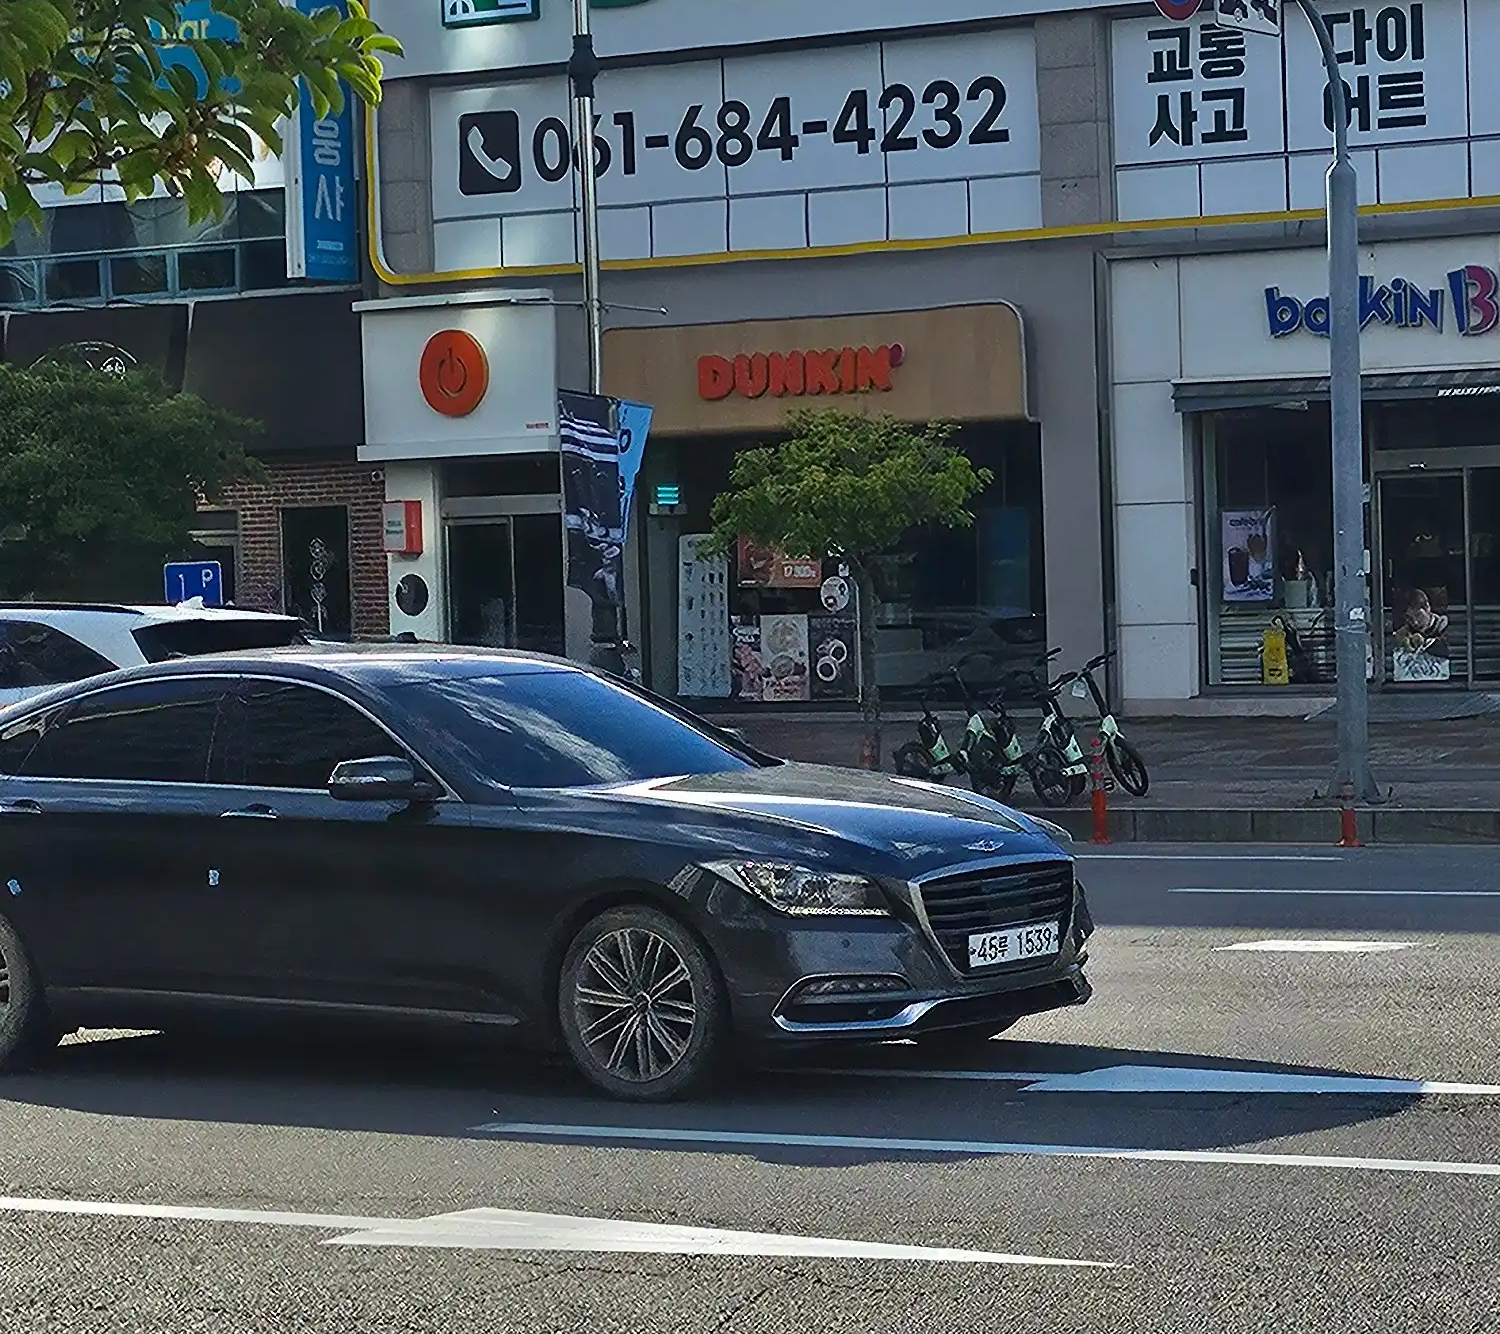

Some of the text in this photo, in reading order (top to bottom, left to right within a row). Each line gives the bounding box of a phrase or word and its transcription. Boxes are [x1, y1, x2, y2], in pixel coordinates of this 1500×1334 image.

[1147, 23, 1248, 84] 교통
[1321, 3, 1425, 67] 다이
[533, 76, 1010, 183] 061-684-4232
[1149, 87, 1248, 148] 사고
[1323, 71, 1427, 133] 어트
[1264, 274, 1445, 338] bakin
[698, 342, 904, 401] DUNKIN'
[201, 568, 213, 588] P
[1017, 927, 1052, 956] 1539
